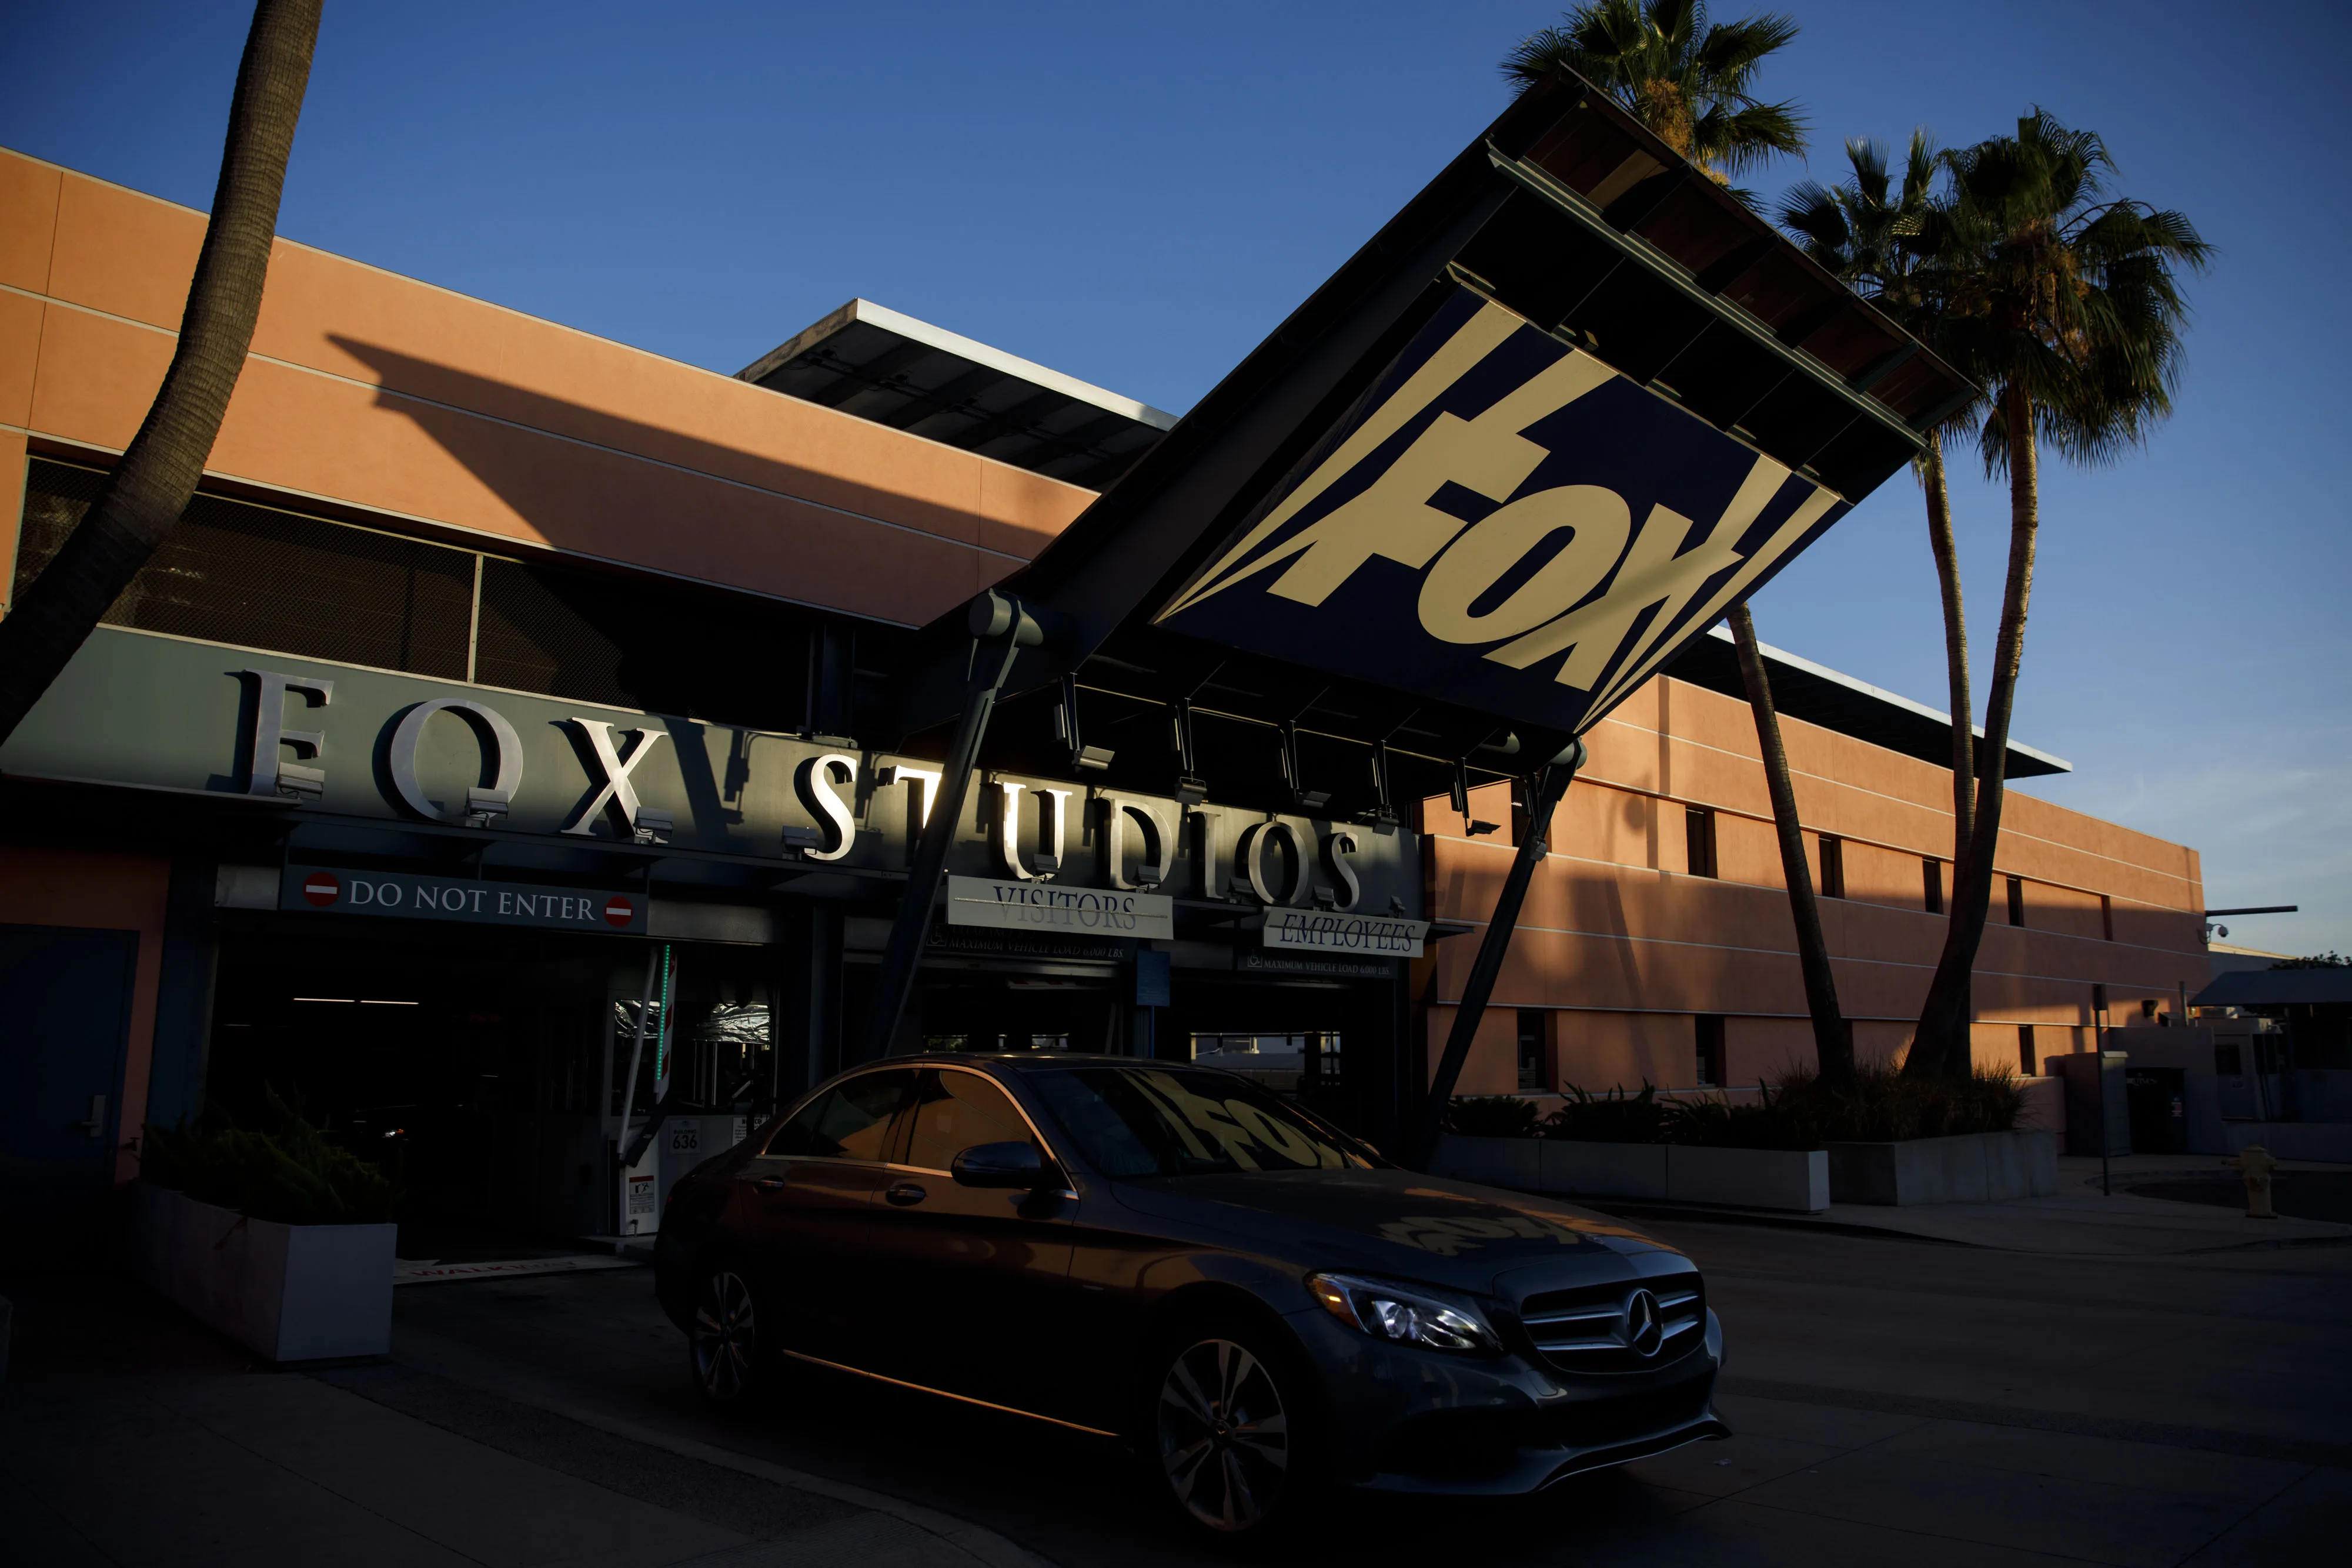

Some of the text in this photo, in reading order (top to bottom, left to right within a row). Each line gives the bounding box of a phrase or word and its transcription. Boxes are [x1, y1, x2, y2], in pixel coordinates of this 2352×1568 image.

[1266, 410, 1745, 692] FOX
[245, 668, 668, 845] FOX
[348, 880, 597, 921] DO NOT ENTER
[993, 886, 1136, 930] VISITORS
[948, 938, 1003, 951] MAXIMUM
[1008, 941, 1048, 954] VEHICLE
[1280, 914, 1415, 951] EMPLOYEES
[1264, 959, 1302, 970] MAXIMUM
[1305, 961, 1337, 972] VEHICLE
[1338, 963, 1359, 974] LOAD
[673, 1135, 697, 1149] 636
